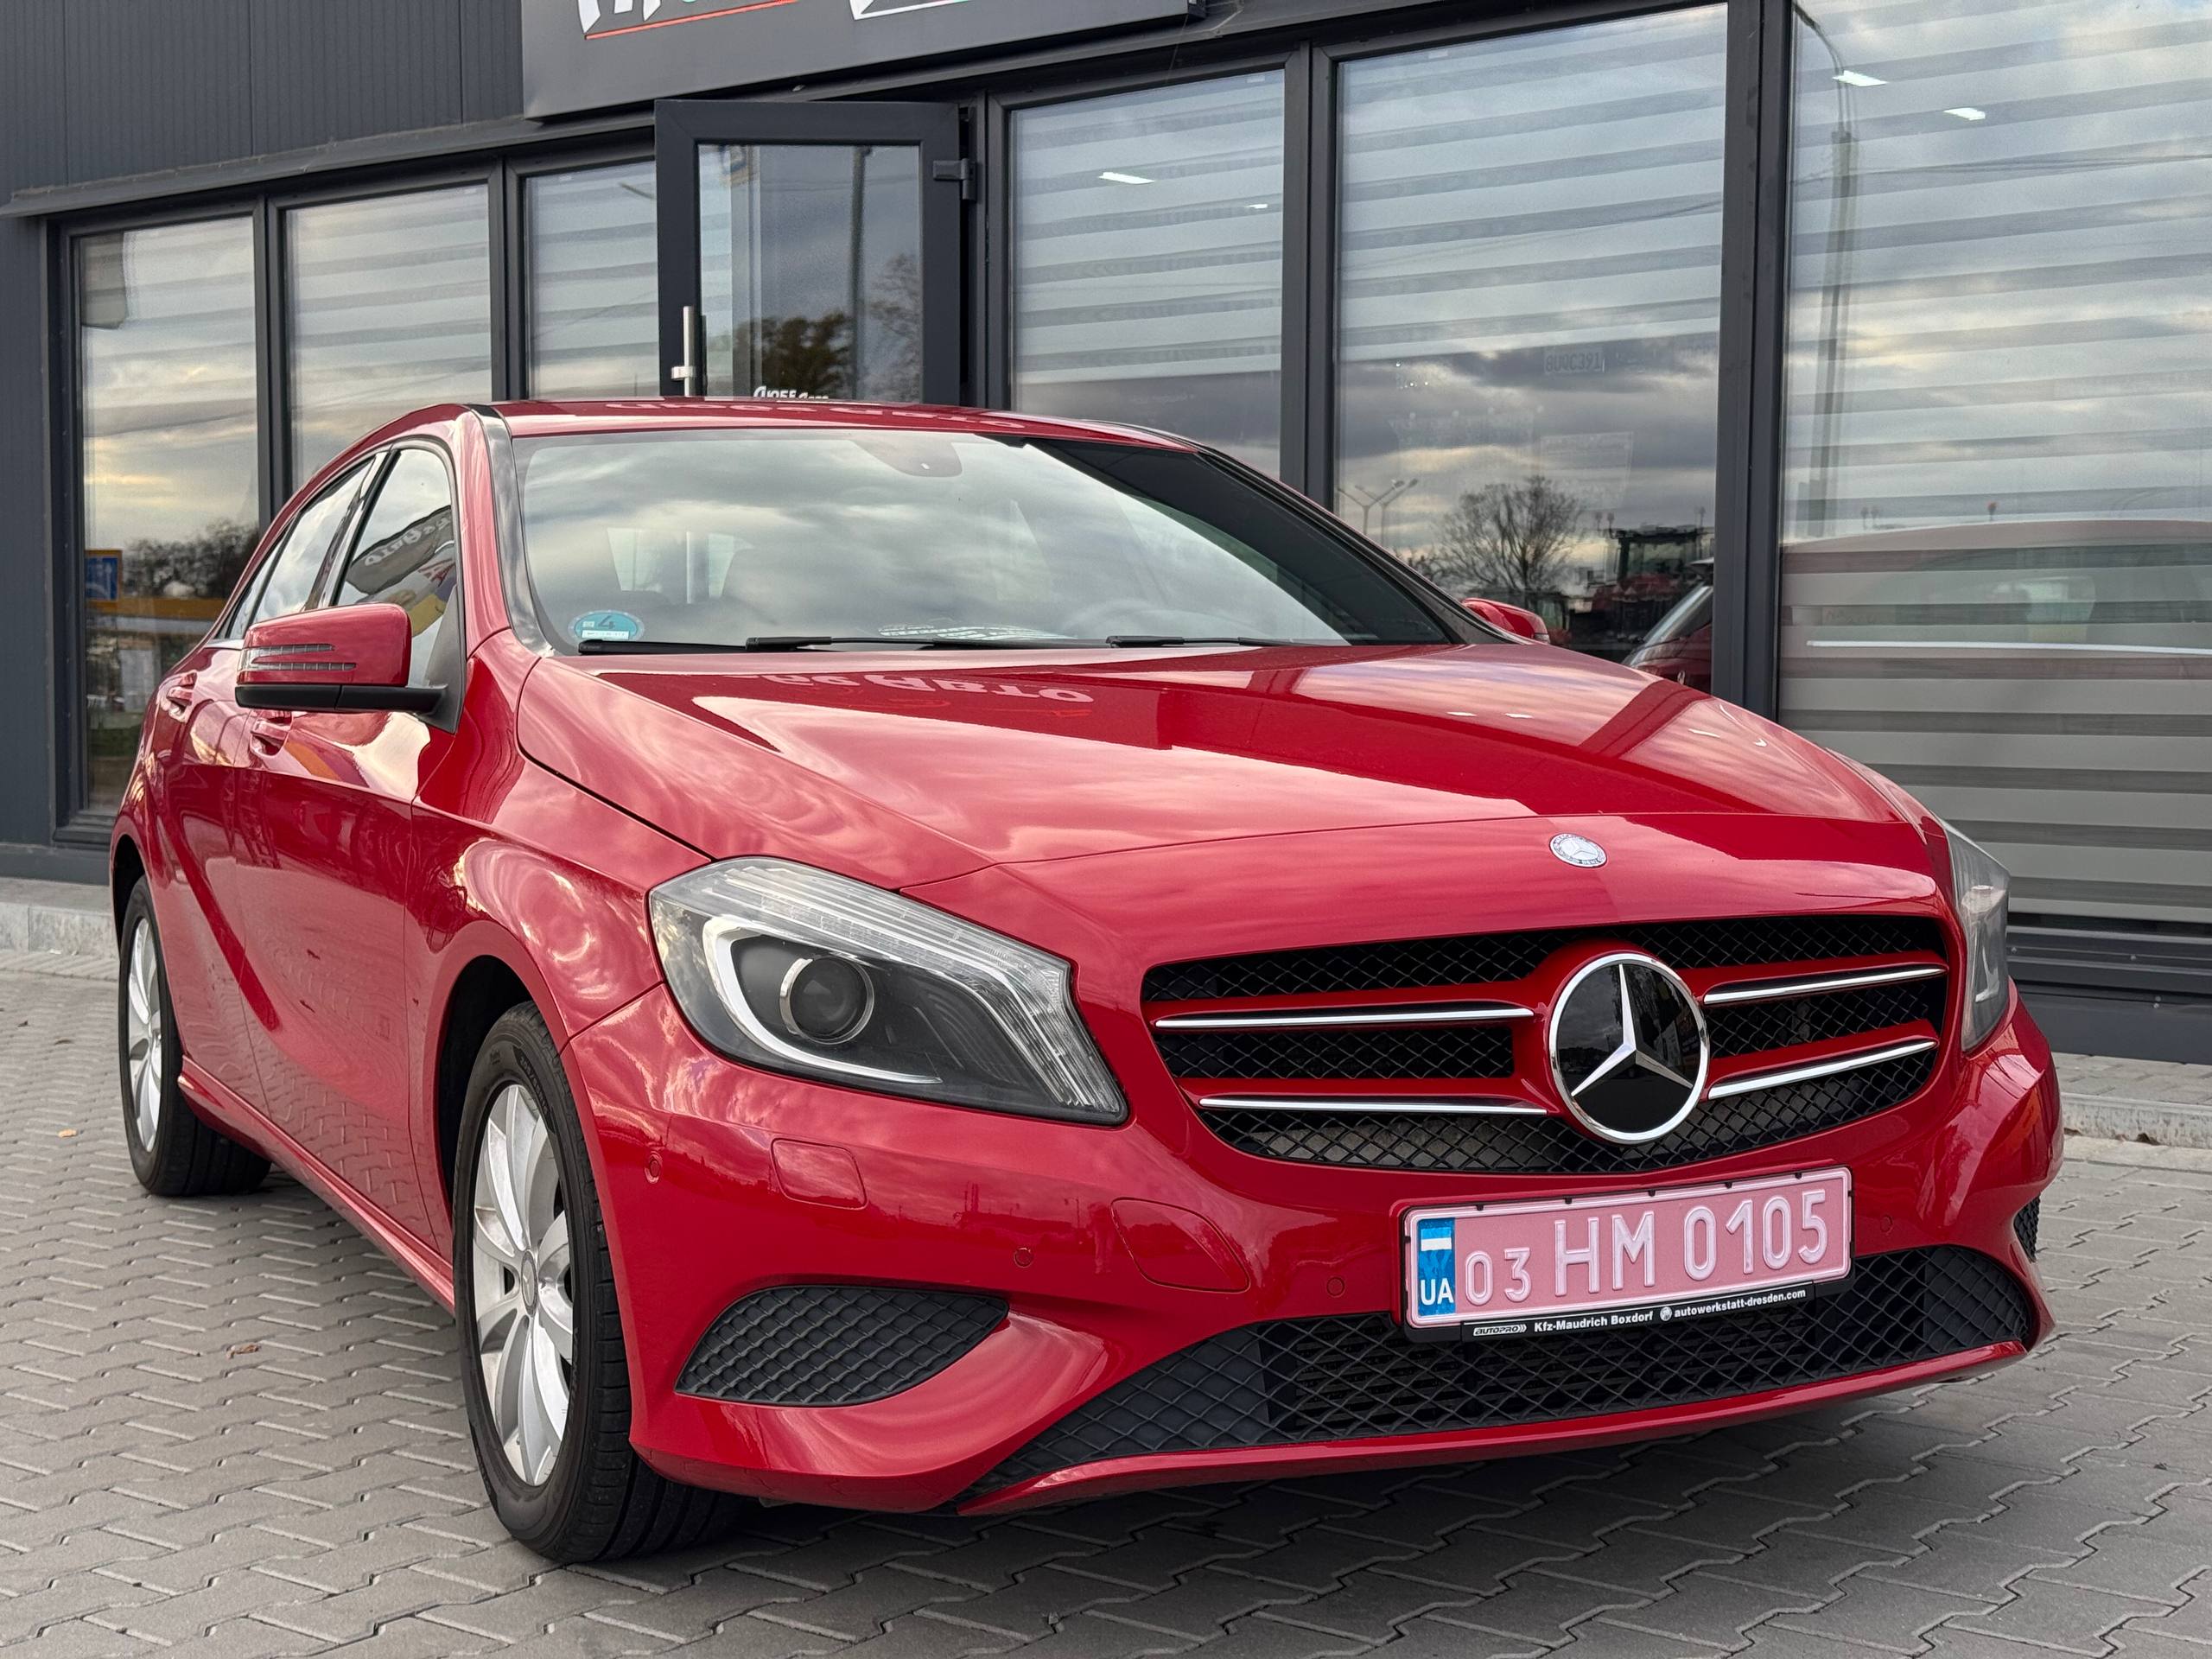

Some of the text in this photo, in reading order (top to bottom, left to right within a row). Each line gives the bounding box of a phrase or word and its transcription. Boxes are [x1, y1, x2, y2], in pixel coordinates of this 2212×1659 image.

[1465, 1189, 1828, 1306] 03 HM 0105
[1421, 1277, 1453, 1306] UA
[1534, 1317, 1608, 1332] Kfz-Maudrich
[1611, 1311, 1654, 1325] Boxdorf
[1674, 1288, 1807, 1318] autowerkstatt-dresden.com
